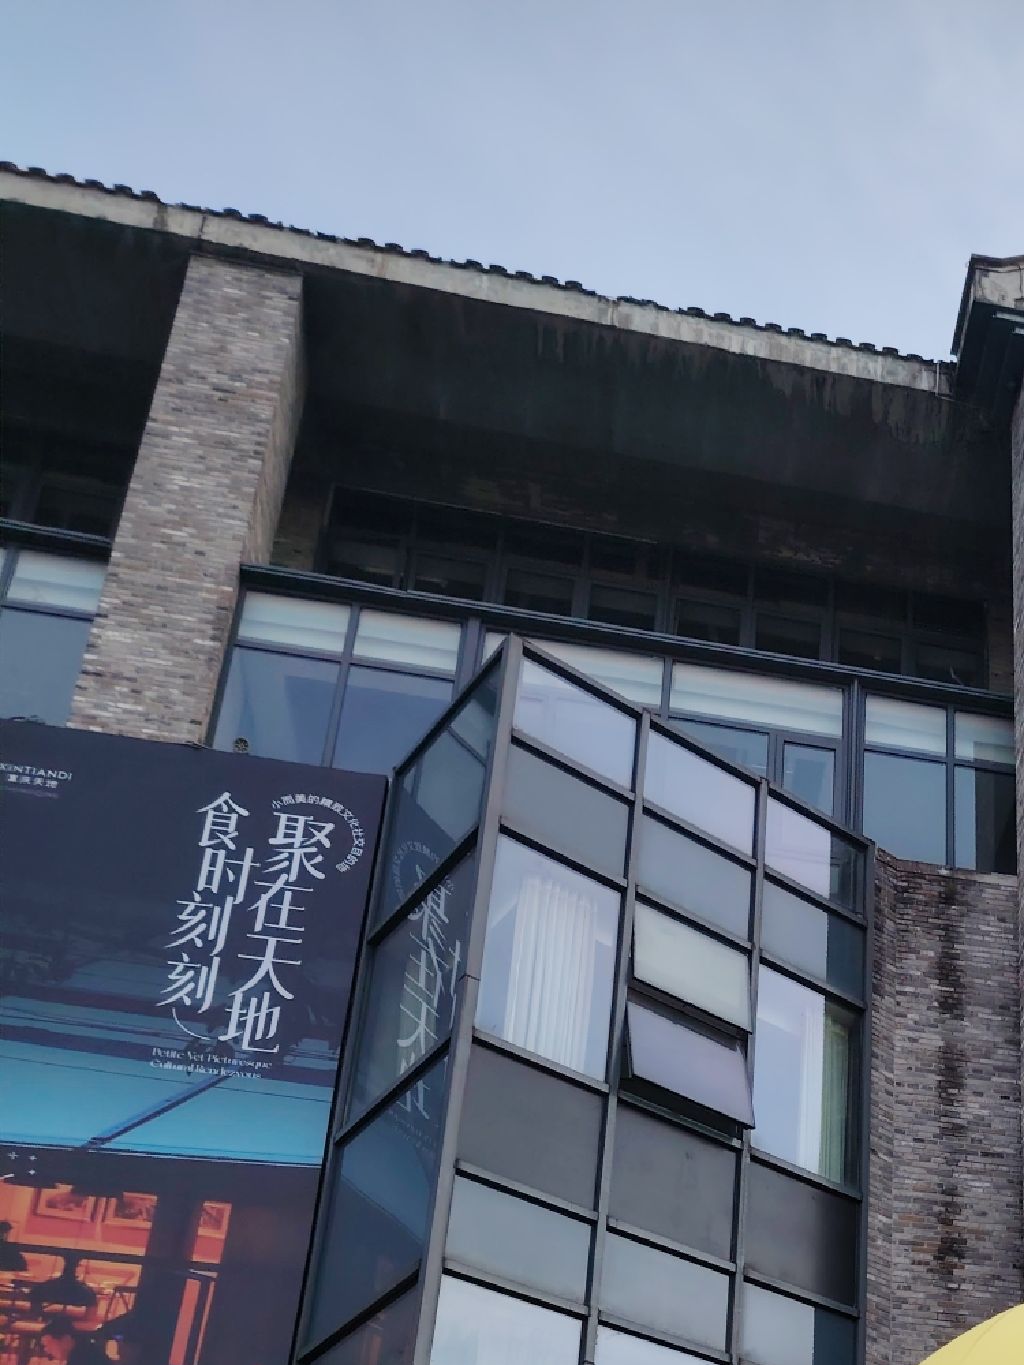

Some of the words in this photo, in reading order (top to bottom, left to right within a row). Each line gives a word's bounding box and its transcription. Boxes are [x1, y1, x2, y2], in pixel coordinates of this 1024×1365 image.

[156, 792, 261, 1014] 食时刻刻
[218, 812, 335, 1052] 聚在天地
